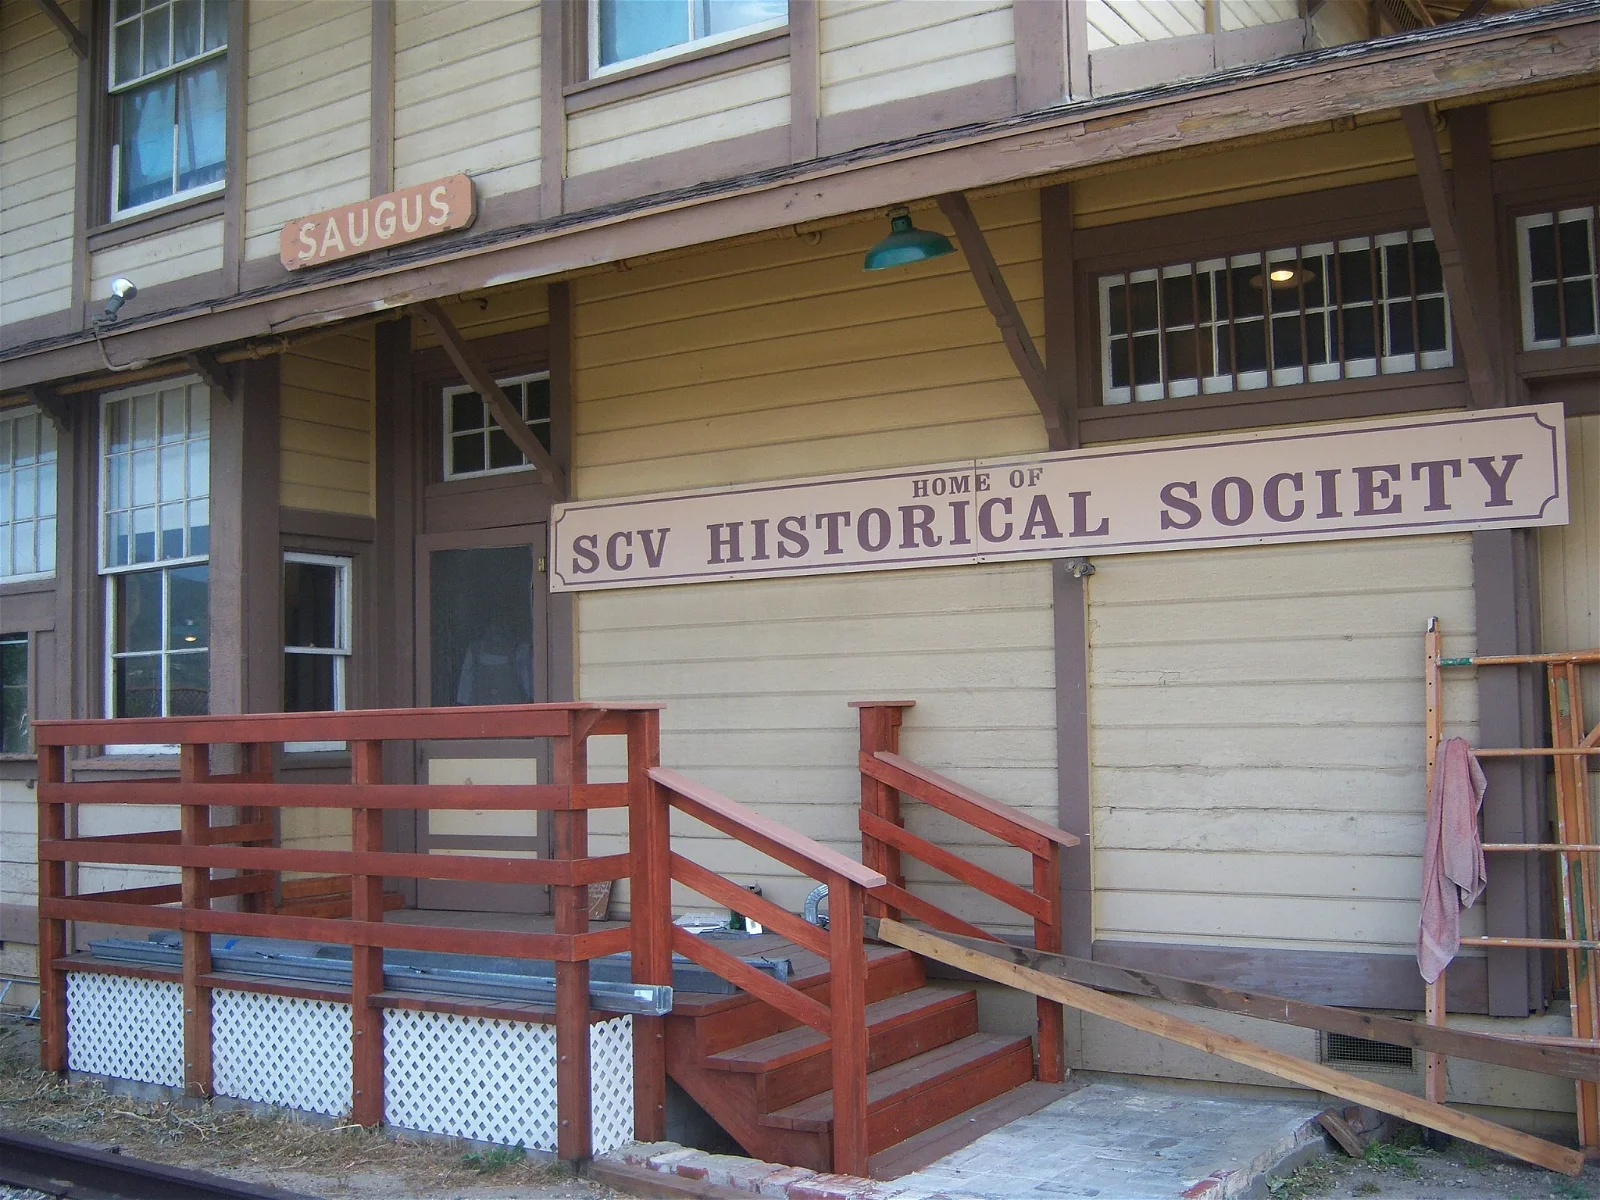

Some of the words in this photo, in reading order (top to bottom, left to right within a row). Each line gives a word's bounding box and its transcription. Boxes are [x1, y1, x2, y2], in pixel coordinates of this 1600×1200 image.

[298, 186, 450, 261] SAUGUS
[572, 527, 671, 575] SCV
[707, 490, 1110, 565] HISTORICAL
[1159, 453, 1523, 531] SOCIETY
[912, 473, 991, 498] HOME
[1009, 467, 1043, 489] OF
